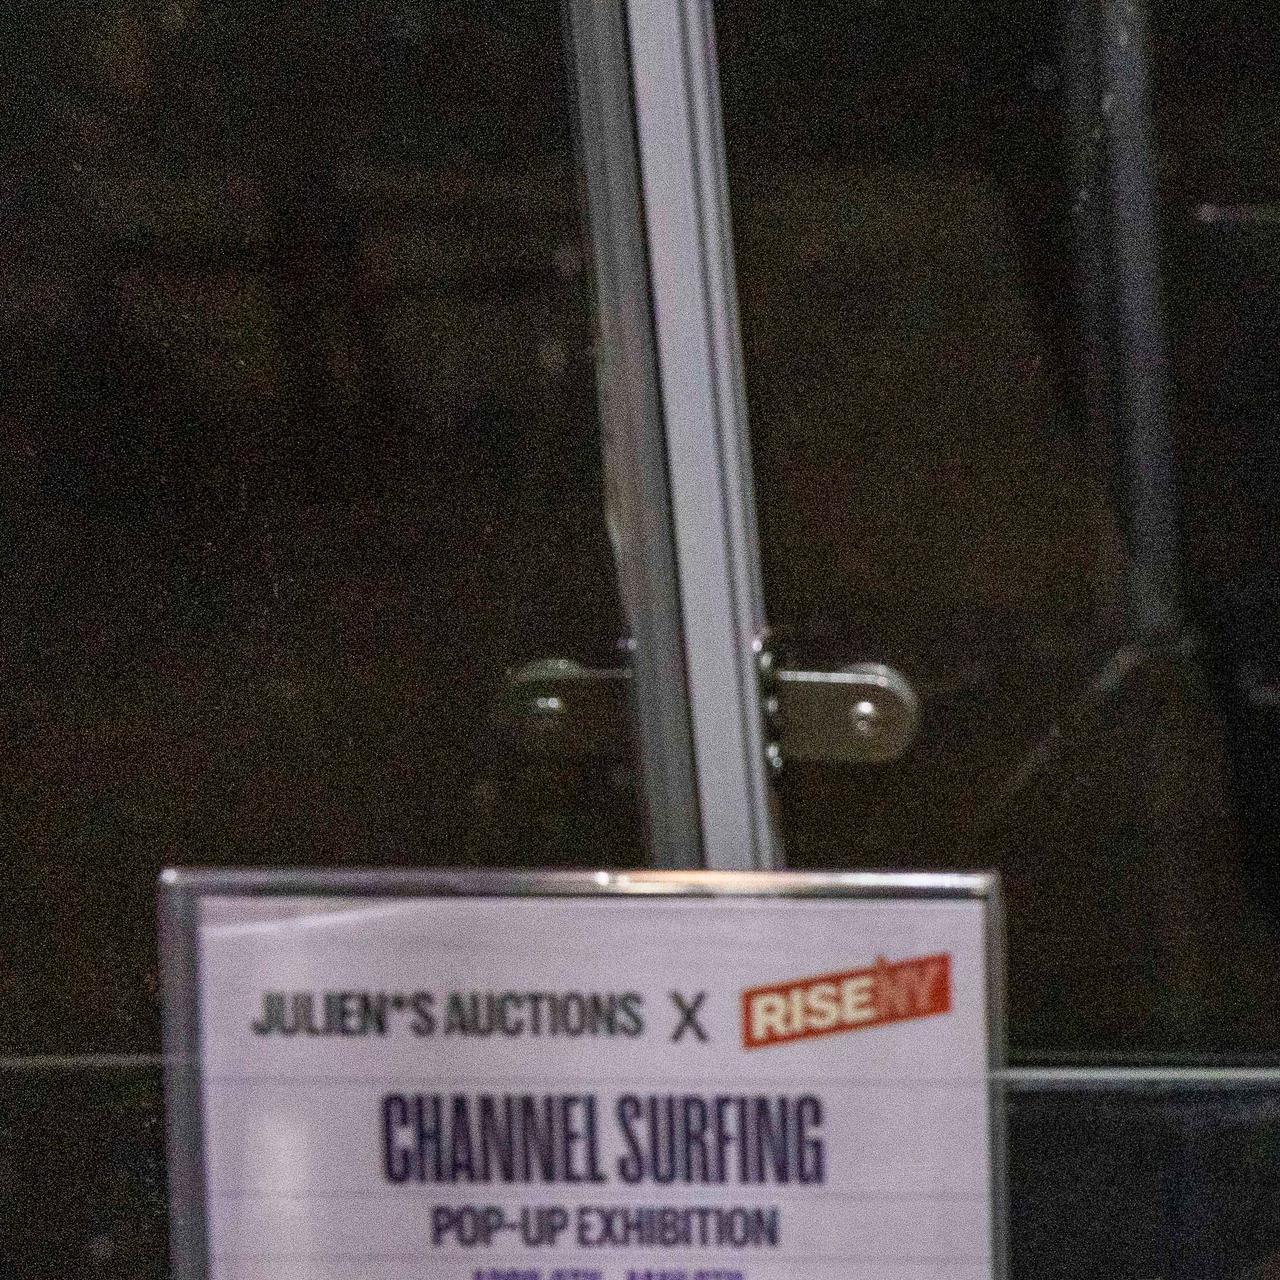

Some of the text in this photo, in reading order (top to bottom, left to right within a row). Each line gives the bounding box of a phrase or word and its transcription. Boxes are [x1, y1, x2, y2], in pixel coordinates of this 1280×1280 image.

[443, 990, 646, 1038] AUCTIONS
[670, 991, 709, 1043] X
[379, 1092, 827, 1185] CHANNEL SURFING
[430, 1205, 780, 1249] POP-UP EXHIBITION
